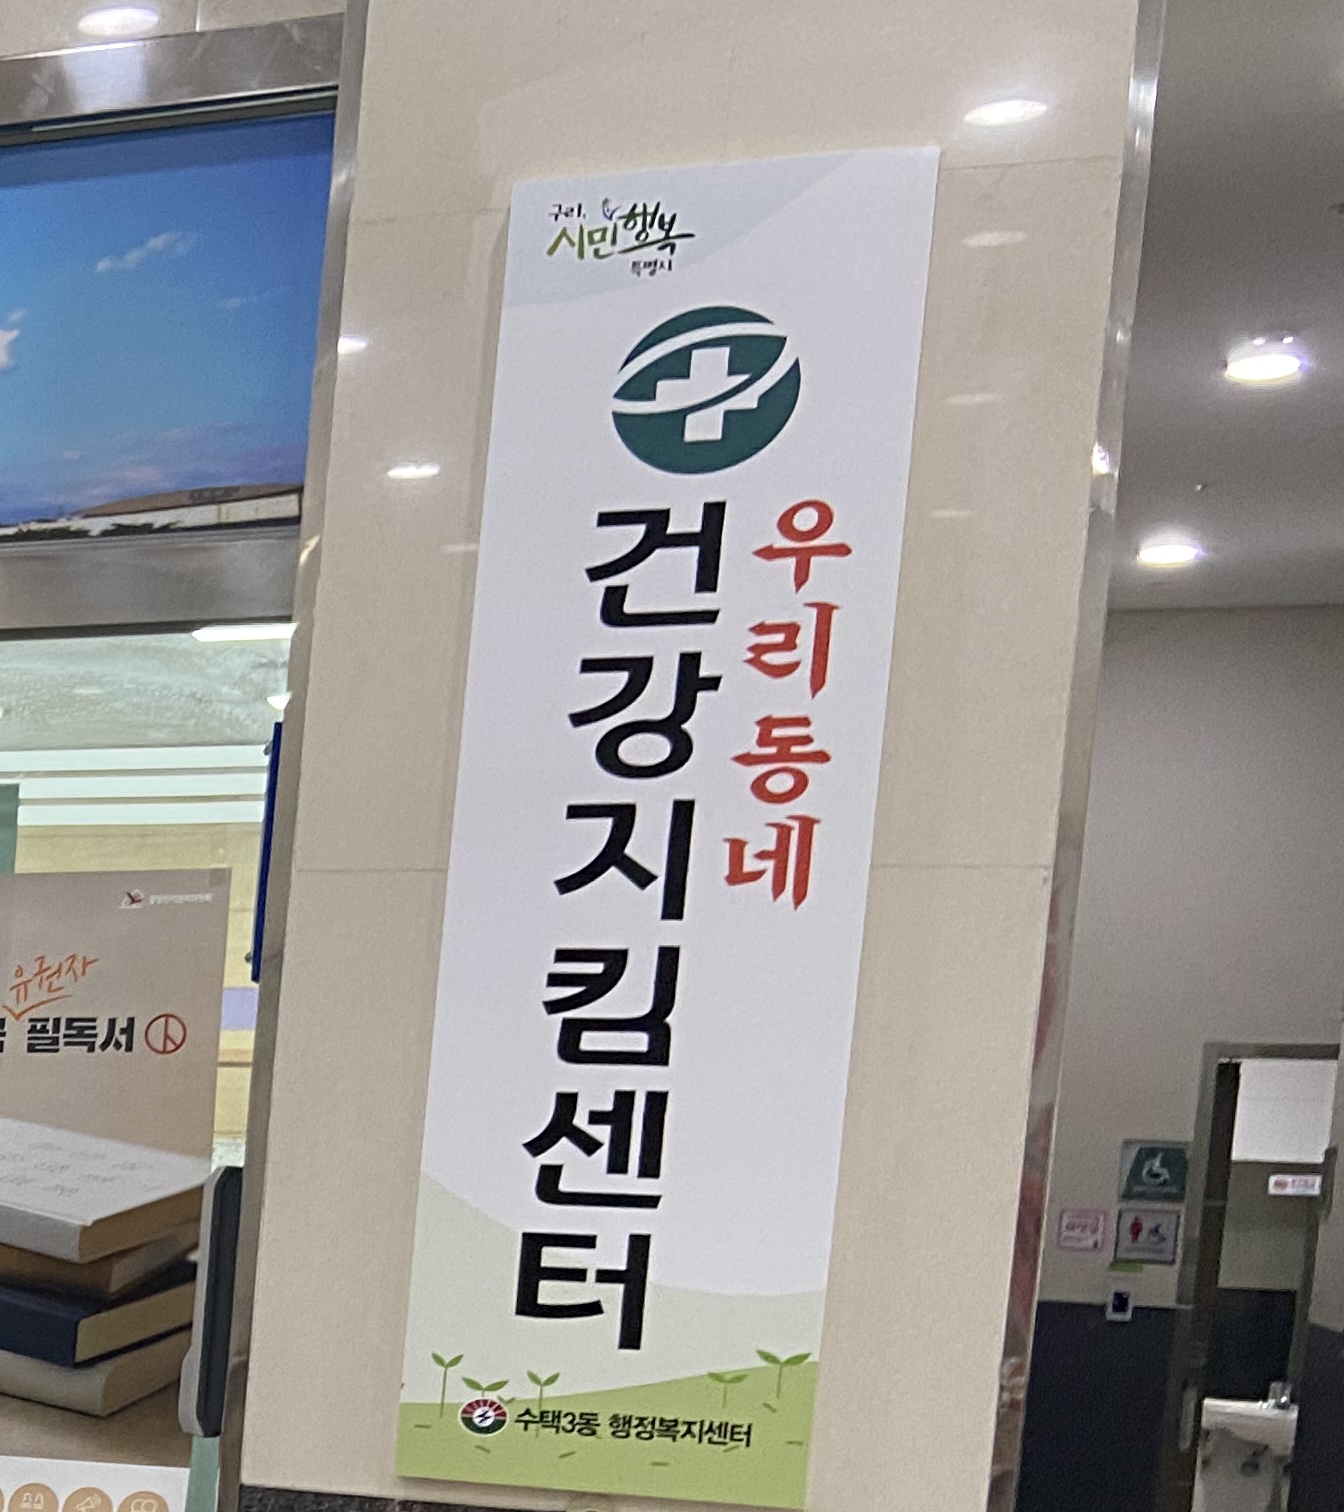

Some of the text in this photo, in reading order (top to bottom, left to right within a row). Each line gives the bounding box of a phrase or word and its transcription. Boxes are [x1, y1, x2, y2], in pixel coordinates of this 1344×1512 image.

[724, 499, 853, 911] 우리동네
[515, 501, 727, 1350] 건강지킴센터
[6, 953, 101, 1006] 유권자
[26, 1016, 136, 1054] 필독서
[515, 1408, 753, 1448] 수택3동 행정복지센터
